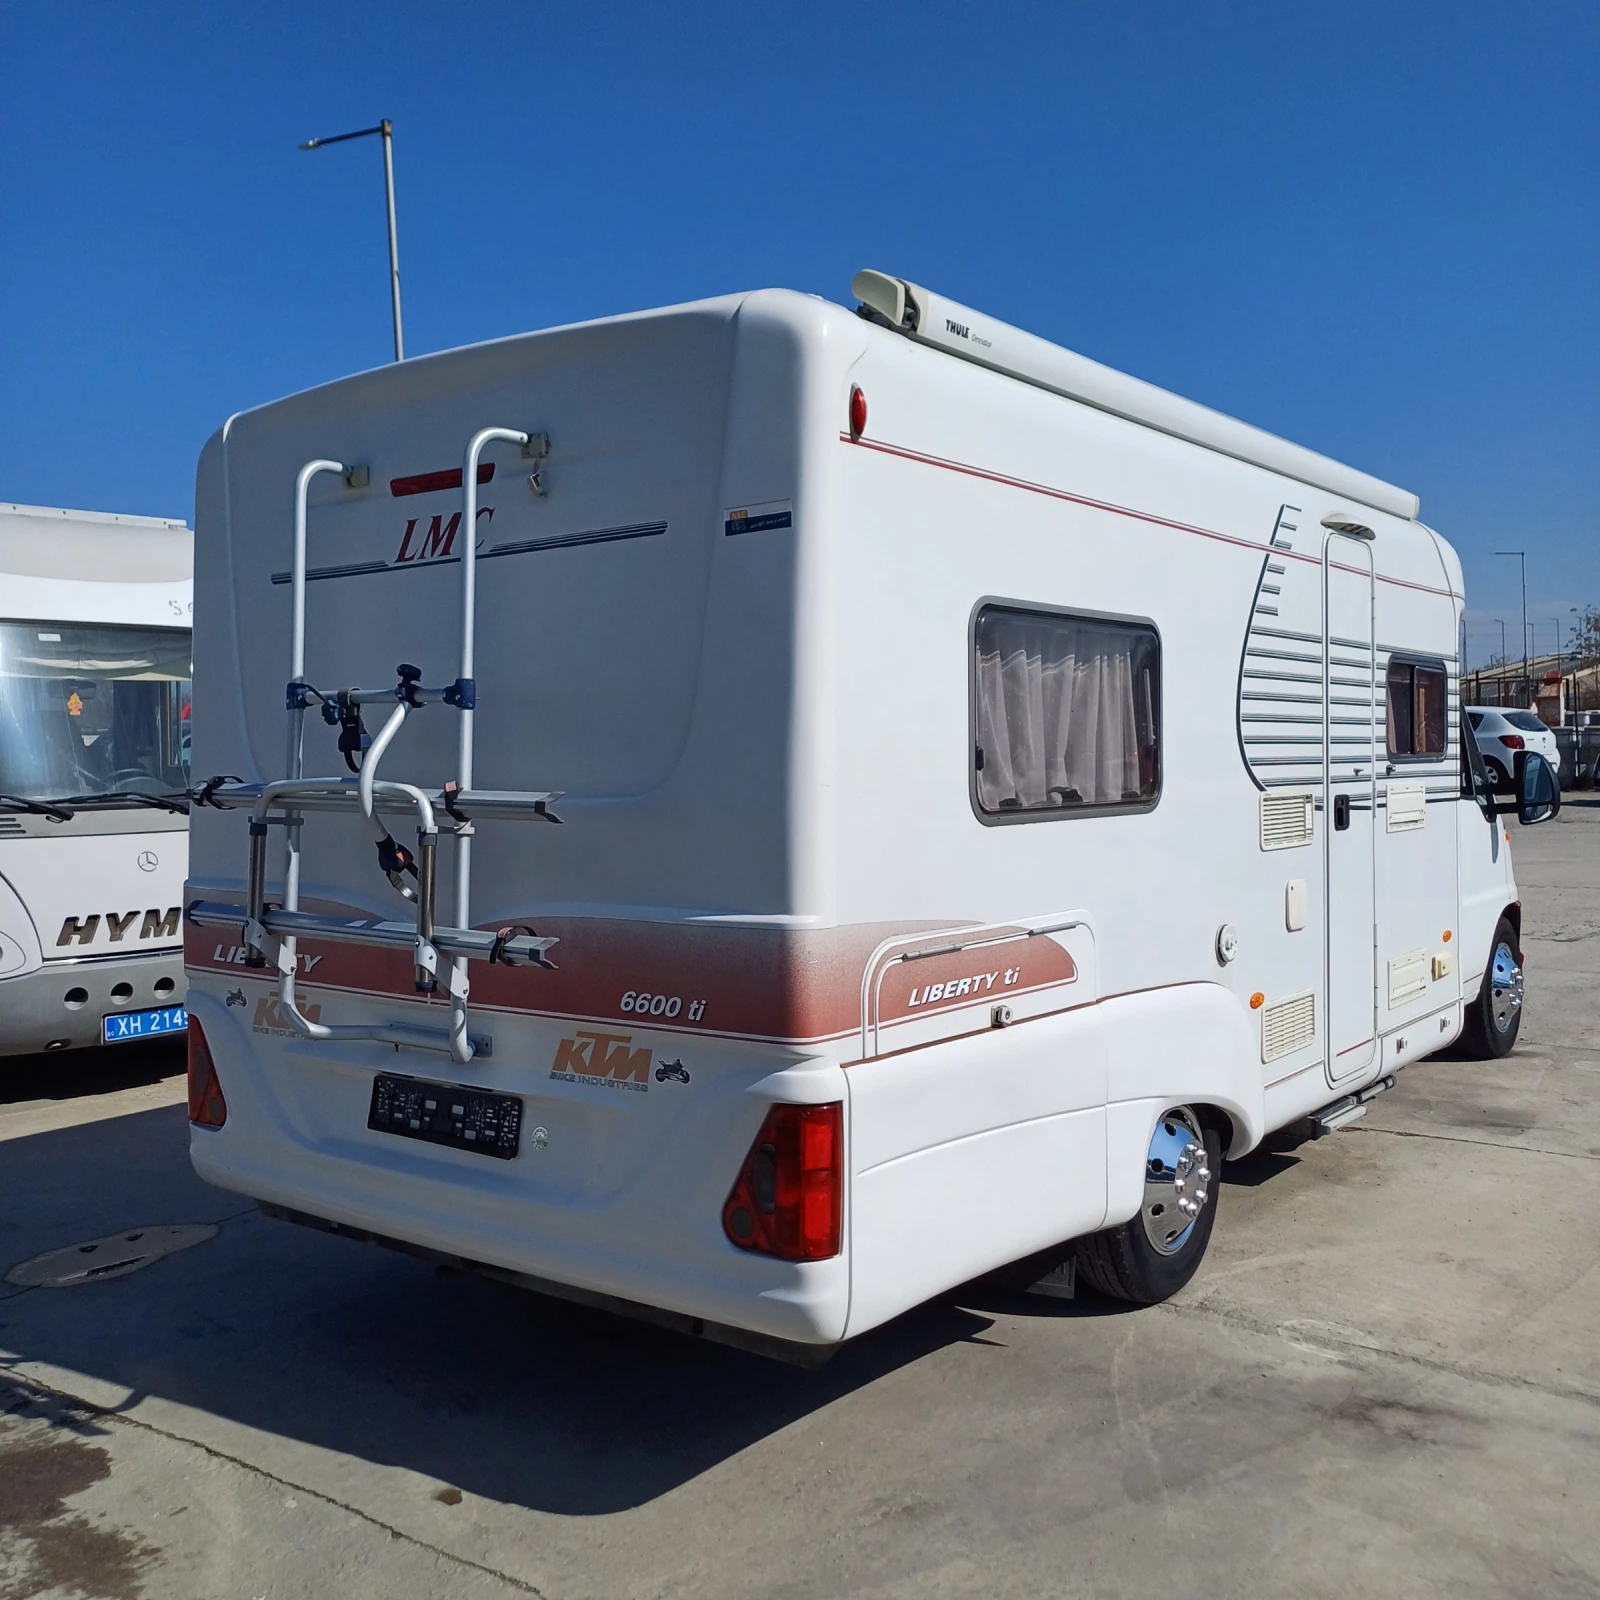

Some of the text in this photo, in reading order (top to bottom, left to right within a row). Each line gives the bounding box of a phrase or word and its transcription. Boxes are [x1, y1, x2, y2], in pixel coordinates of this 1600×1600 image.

[946, 318, 970, 339] THULE
[908, 967, 1021, 1007] LIBERTY ti
[620, 991, 707, 1021] 6600 ti
[118, 1016, 142, 1036] XH
[552, 1031, 653, 1083] KTM
[549, 1070, 649, 1093] BIKE INDUSTRIES
